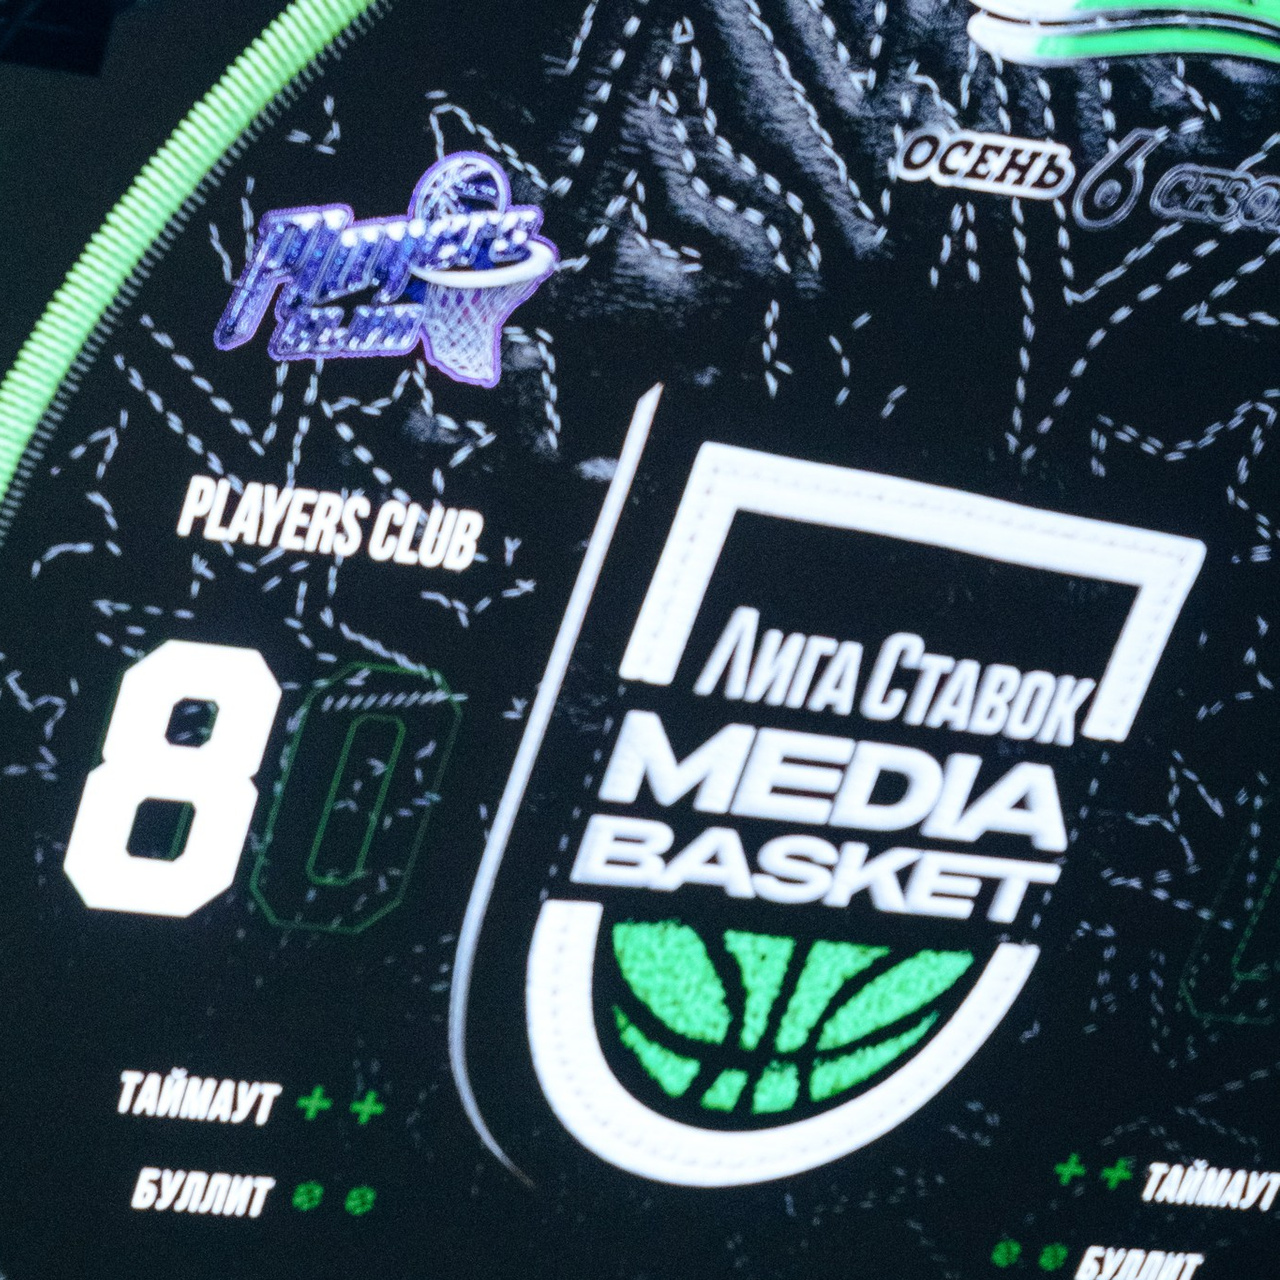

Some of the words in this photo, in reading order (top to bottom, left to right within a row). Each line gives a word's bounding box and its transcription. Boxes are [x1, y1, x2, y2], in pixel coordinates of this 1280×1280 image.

[902, 133, 1067, 190] ОСЕНЬ
[1150, 163, 1280, 232] СЕЗО
[176, 474, 371, 557] PLAYERS
[368, 498, 484, 572] CLUB
[598, 709, 1069, 853] MEDIA
[569, 813, 1062, 924] BASKET
[117, 1066, 283, 1126] ТАЙМАУТ
[130, 1166, 277, 1218] БУЛЛИТ
[1141, 1158, 1280, 1213] ТАЙМАУТ
